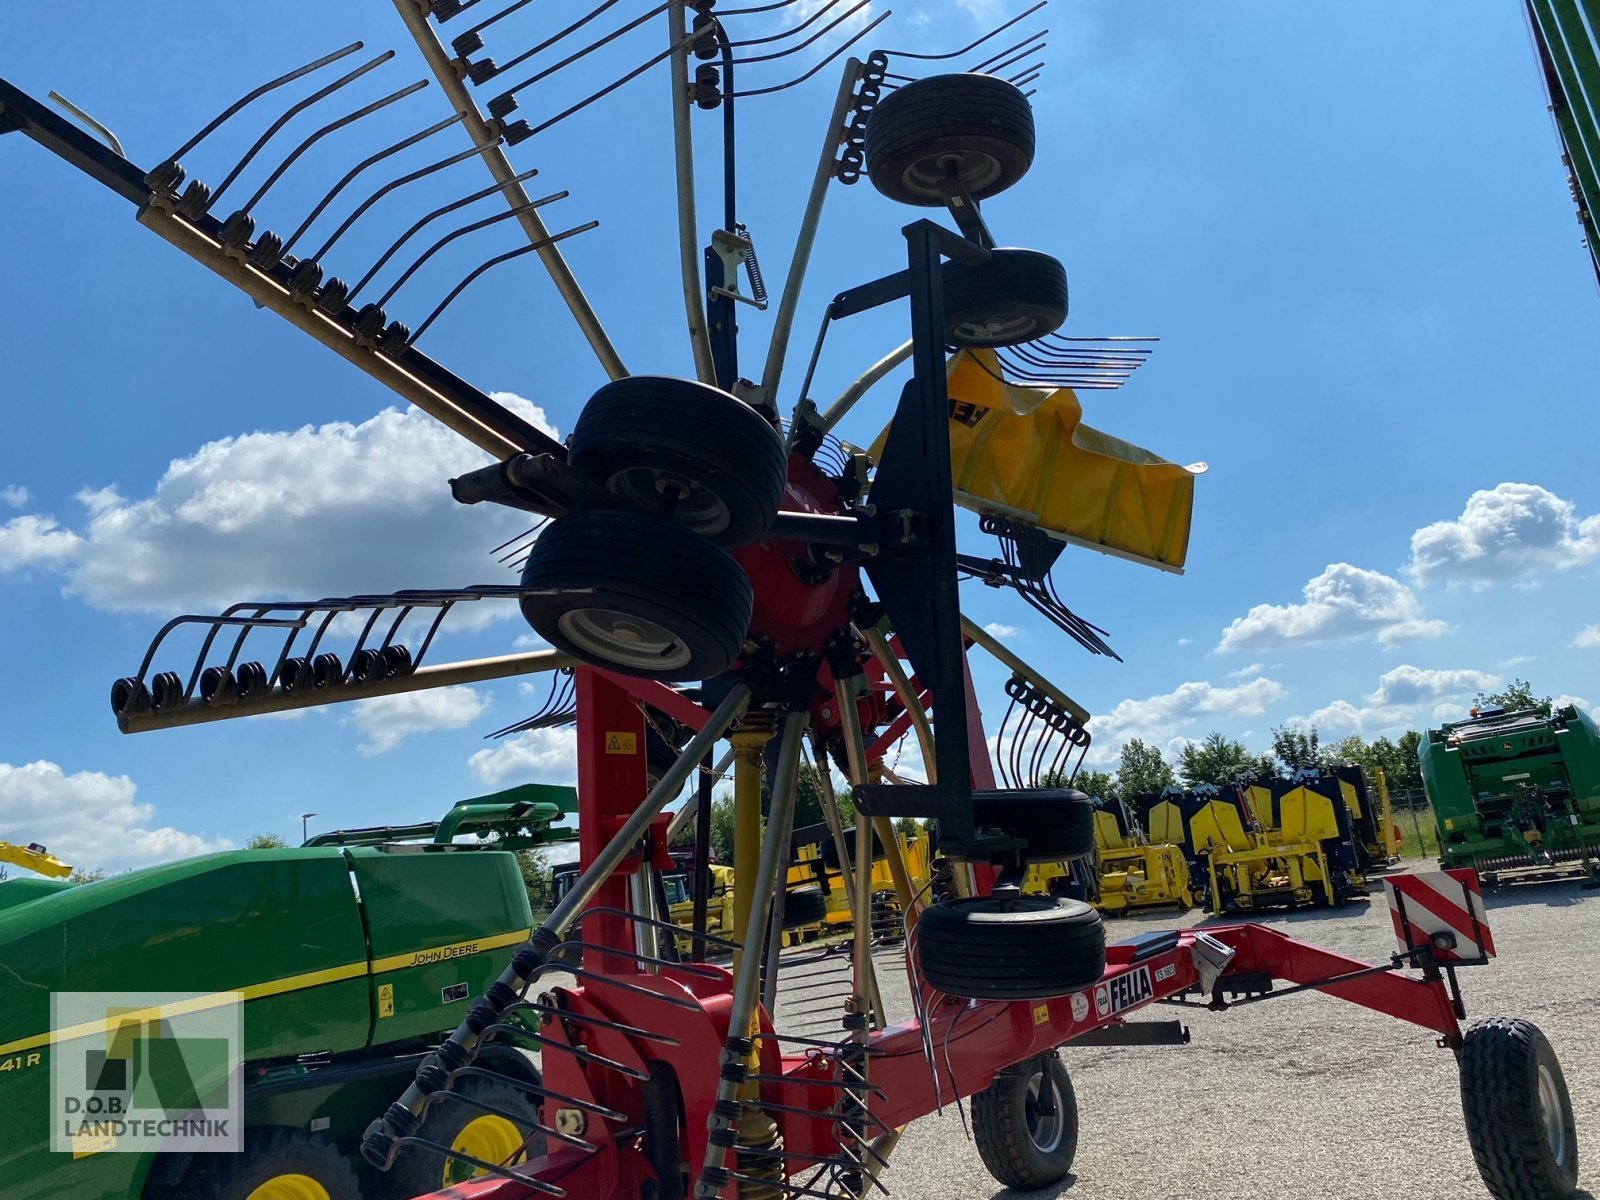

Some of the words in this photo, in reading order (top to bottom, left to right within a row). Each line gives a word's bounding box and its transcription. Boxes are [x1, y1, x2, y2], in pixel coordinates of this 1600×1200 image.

[410, 950, 442, 966] JOHN
[443, 942, 479, 959] DEERE
[1157, 970, 1166, 980] TS
[1110, 968, 1152, 1013] FELLA
[1097, 995, 1108, 1006] FELLA
[27, 1052, 41, 1067] R
